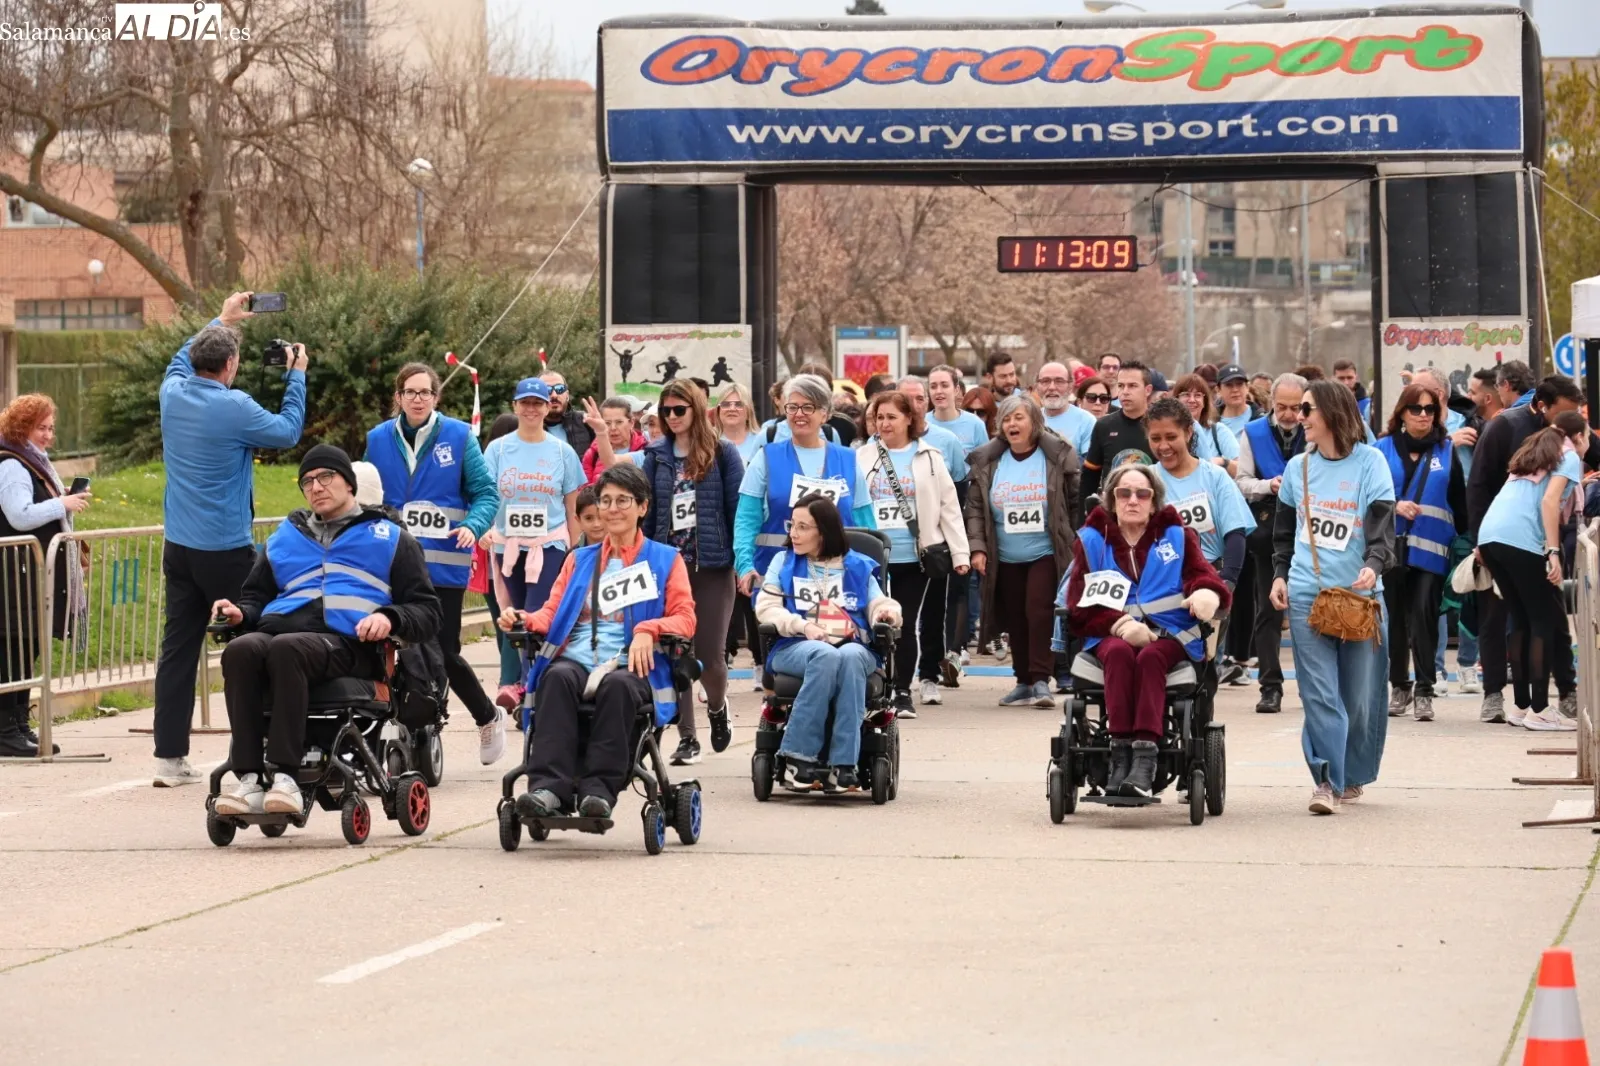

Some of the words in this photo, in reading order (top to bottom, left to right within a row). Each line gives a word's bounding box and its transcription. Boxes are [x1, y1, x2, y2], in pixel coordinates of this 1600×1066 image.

[727, 112, 1399, 150] www.orycronsport.com
[1013, 240, 1130, 268] 11:13:09
[407, 510, 446, 529] 508
[509, 513, 545, 528] 685
[676, 501, 697, 520] 54
[878, 507, 903, 520] 57
[1008, 510, 1041, 525] 644
[1179, 505, 1207, 526] 99
[1310, 517, 1348, 541] 600
[602, 573, 647, 602] 671
[1086, 580, 1126, 600] 606
